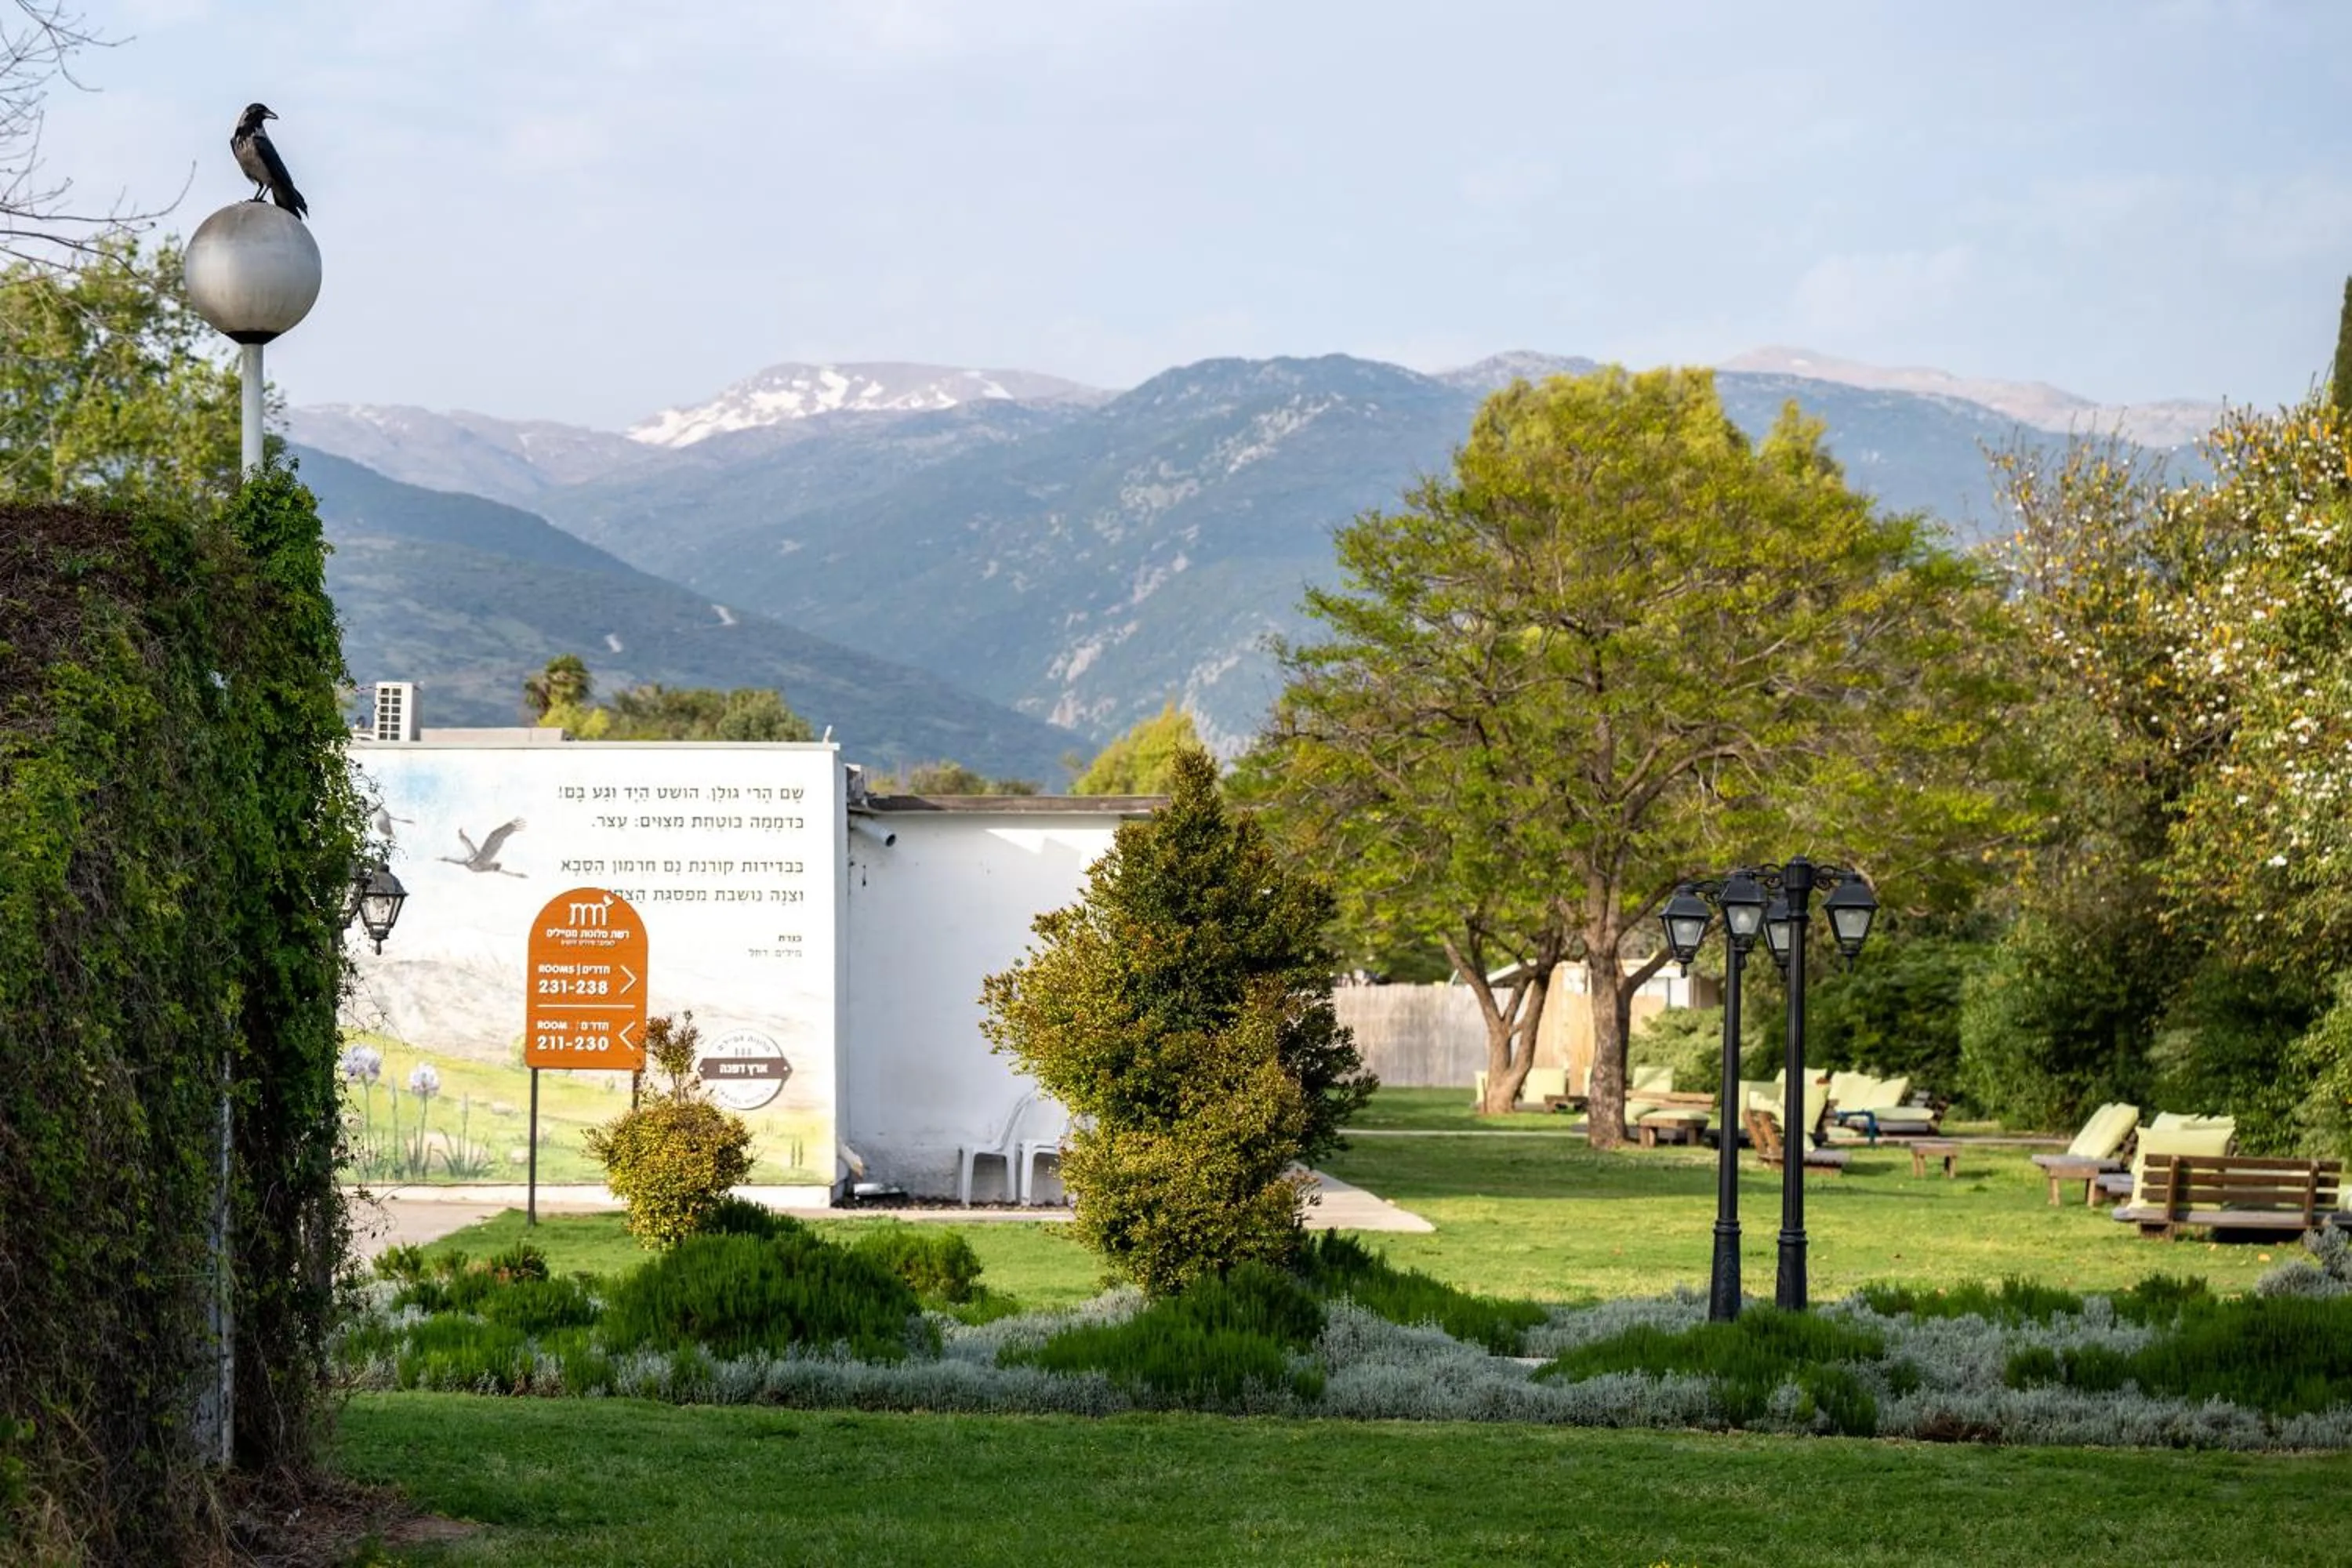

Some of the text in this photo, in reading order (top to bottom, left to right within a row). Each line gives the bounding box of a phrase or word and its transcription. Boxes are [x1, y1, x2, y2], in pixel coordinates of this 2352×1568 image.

[747, 788, 772, 803] הרי
[780, 788, 804, 803] שם
[538, 964, 575, 975] ROOMS
[539, 978, 608, 995] 231-238
[537, 1034, 609, 1051] 211-230
